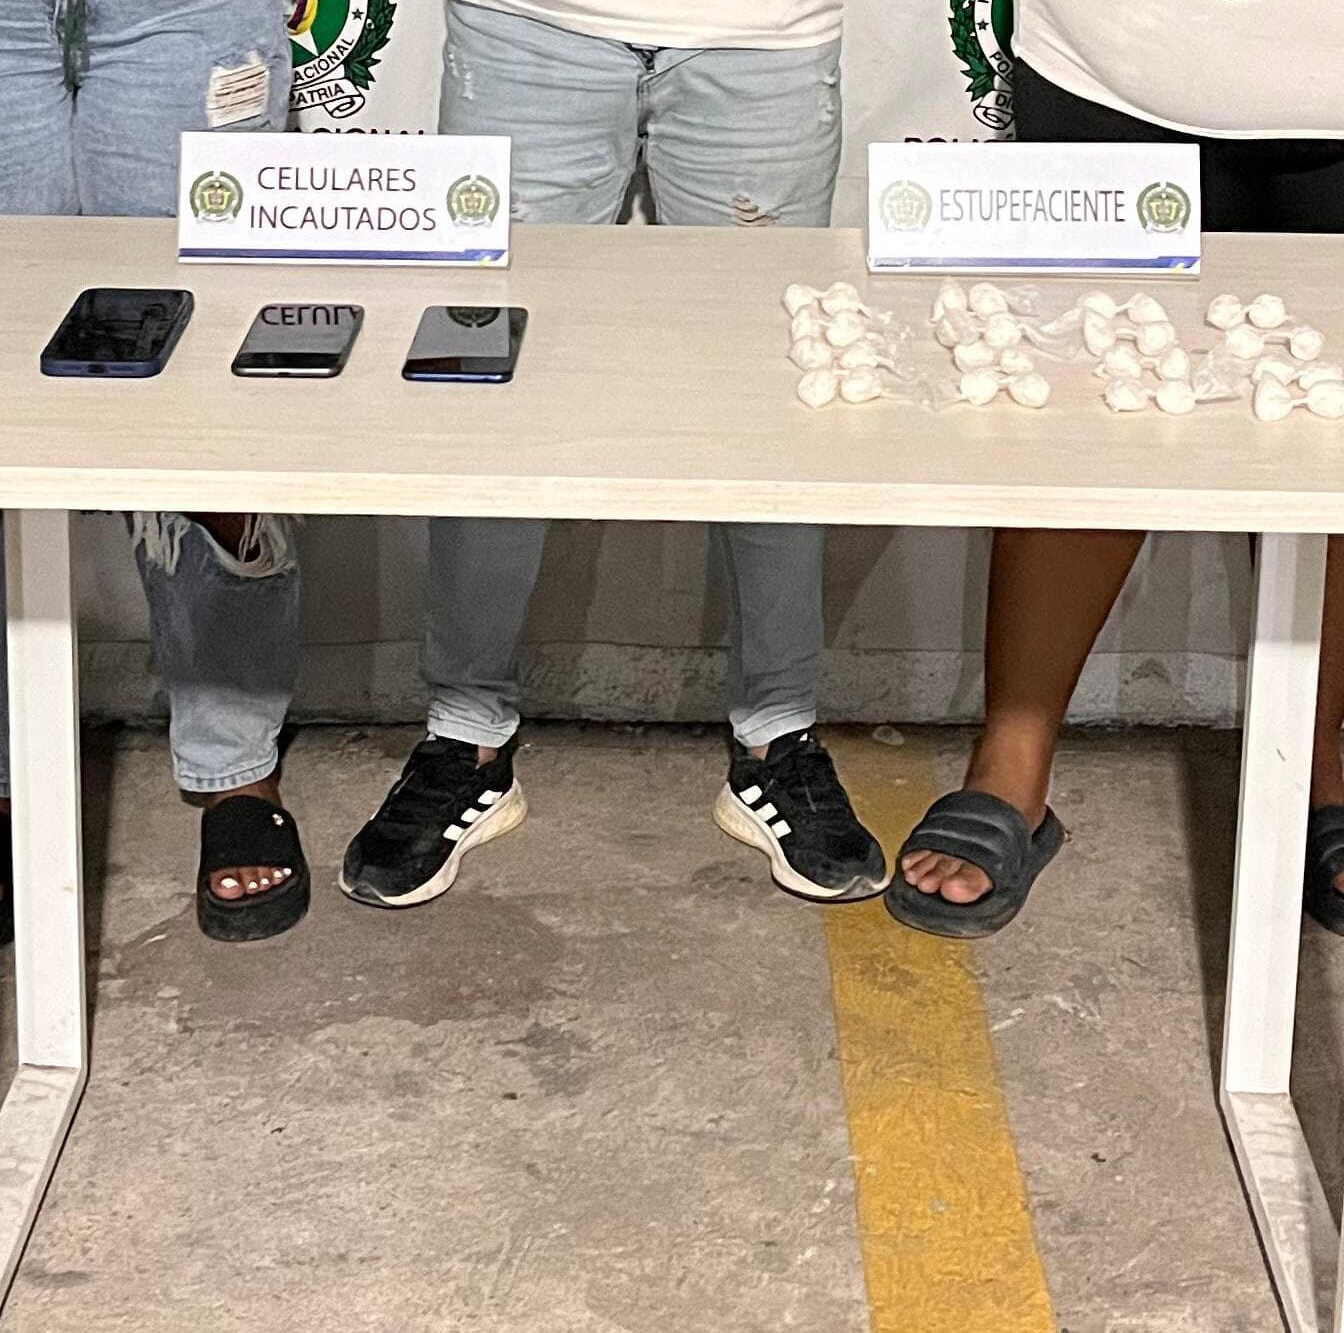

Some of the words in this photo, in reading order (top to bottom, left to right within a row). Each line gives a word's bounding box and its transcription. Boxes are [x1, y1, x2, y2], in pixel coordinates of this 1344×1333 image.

[257, 167, 417, 192] CELULARES
[249, 204, 437, 231] INCAUTADOS
[939, 189, 1126, 223] ESTUPEFACIENTE
